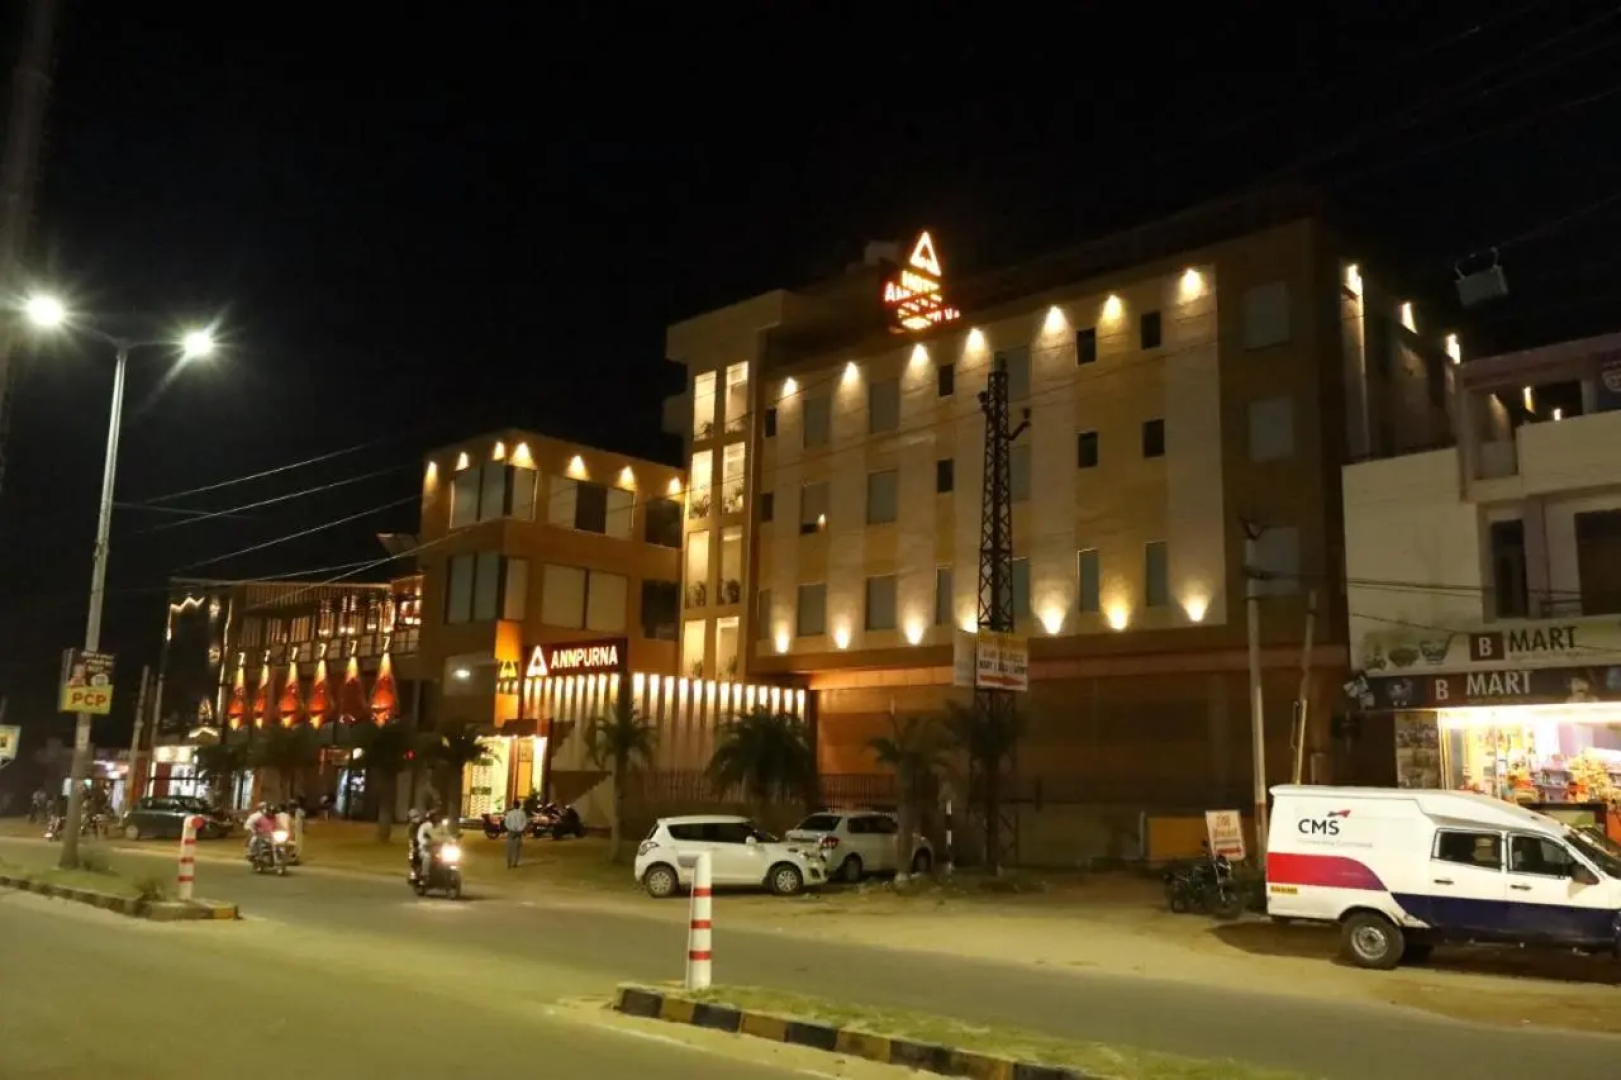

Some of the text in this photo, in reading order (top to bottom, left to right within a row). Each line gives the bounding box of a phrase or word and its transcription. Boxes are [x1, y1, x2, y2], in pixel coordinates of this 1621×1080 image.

[1478, 637, 1493, 657] B
[1509, 625, 1577, 652] MART
[551, 646, 618, 669] ANNPURNA
[1435, 670, 1533, 700] B MART
[71, 692, 106, 706] PCP
[1298, 819, 1340, 835] CMS
